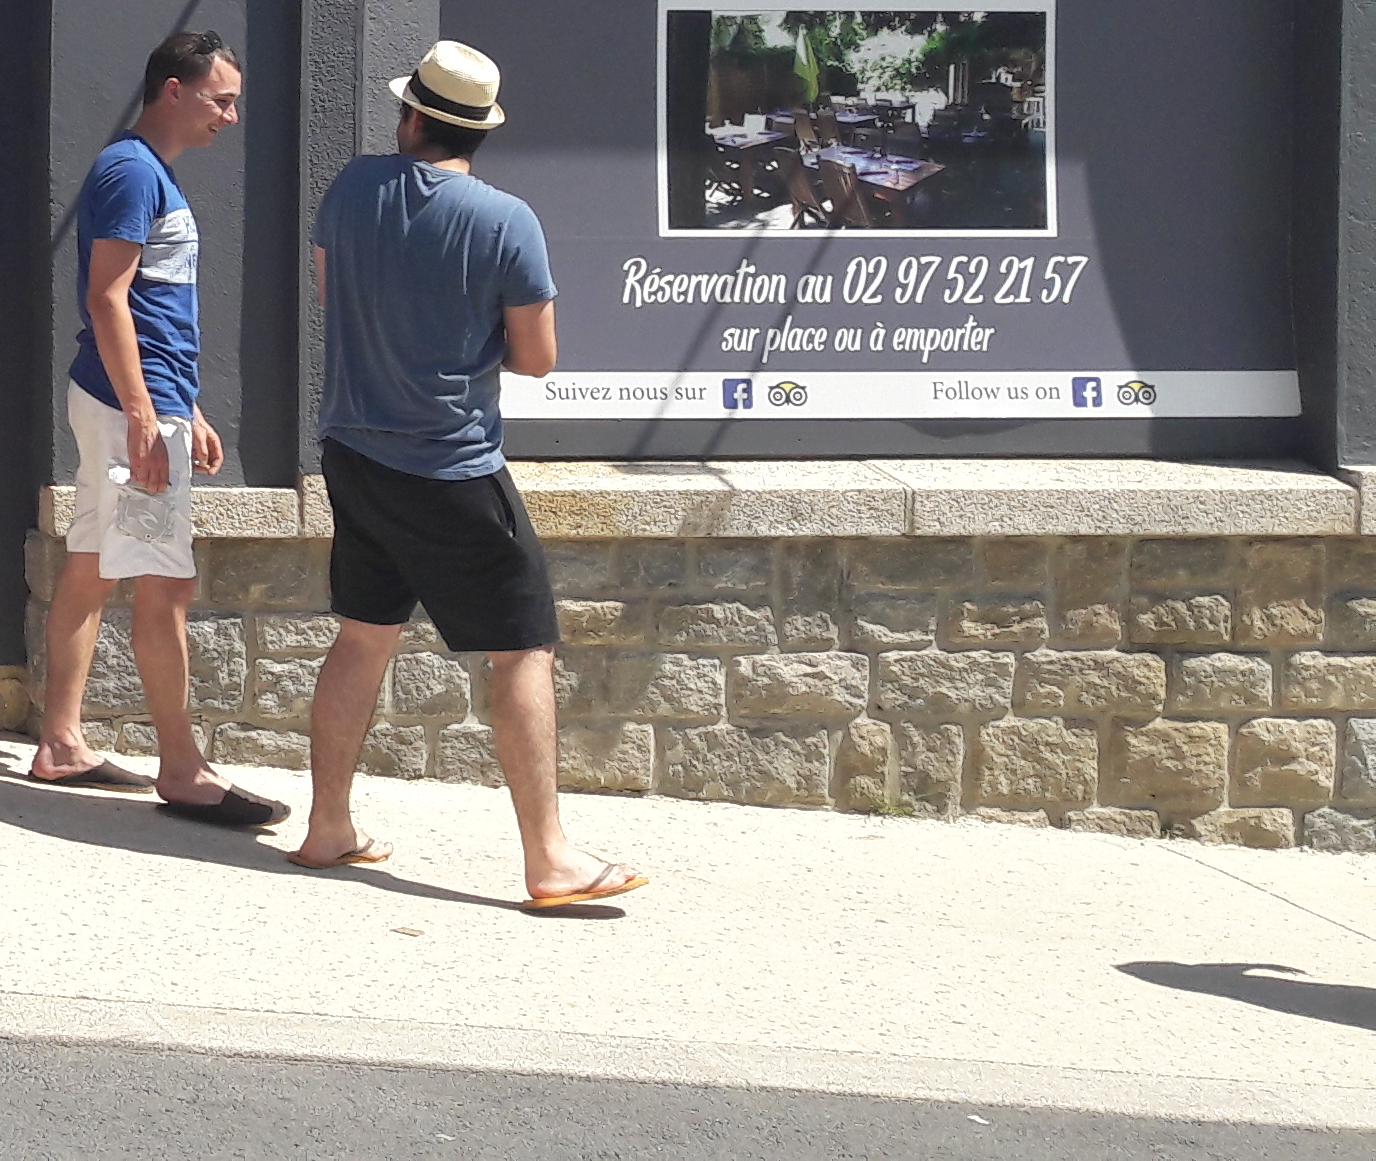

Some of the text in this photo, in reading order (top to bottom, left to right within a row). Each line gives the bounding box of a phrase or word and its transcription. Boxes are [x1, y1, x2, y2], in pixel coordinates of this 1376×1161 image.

[622, 255, 1089, 308] Réservation au 02 97 52 21 57
[721, 314, 995, 364] sur place ou à emporter
[545, 381, 612, 401] Suivez
[618, 386, 669, 401] nous
[674, 386, 707, 401] sur
[932, 379, 1001, 401] Follow
[1006, 386, 1029, 401] us
[1035, 386, 1061, 401] on
